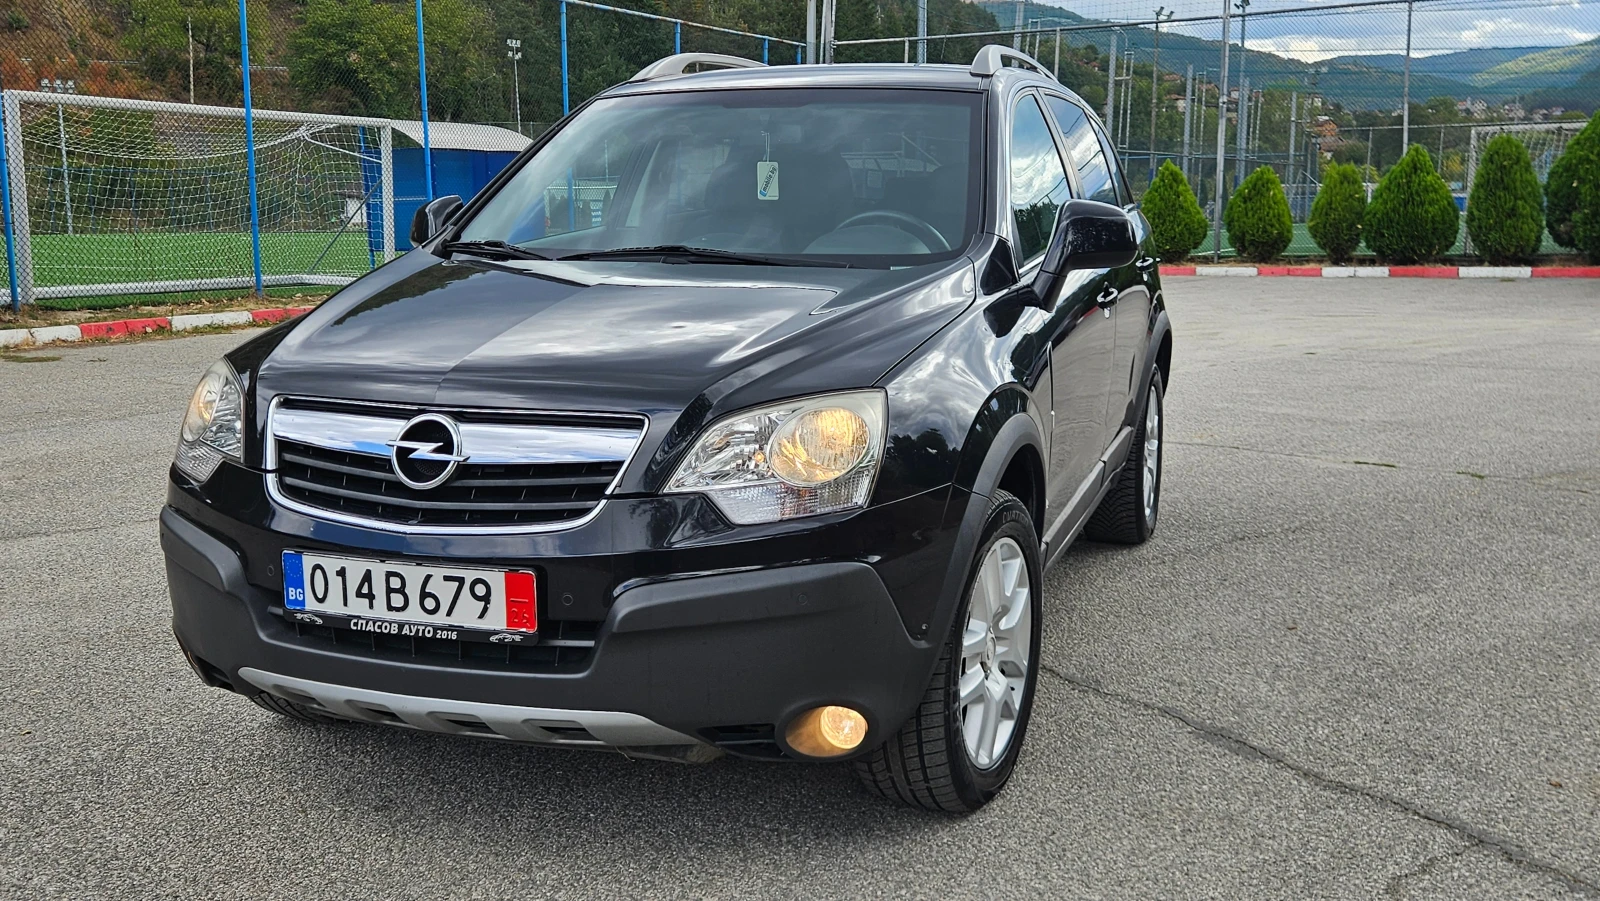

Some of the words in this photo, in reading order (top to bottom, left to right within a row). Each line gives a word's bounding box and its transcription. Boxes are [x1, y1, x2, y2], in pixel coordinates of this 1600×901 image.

[288, 587, 304, 601] BG
[350, 619, 399, 634] СПАСОВ
[401, 624, 434, 638] АУТО
[436, 630, 457, 640] 2016
